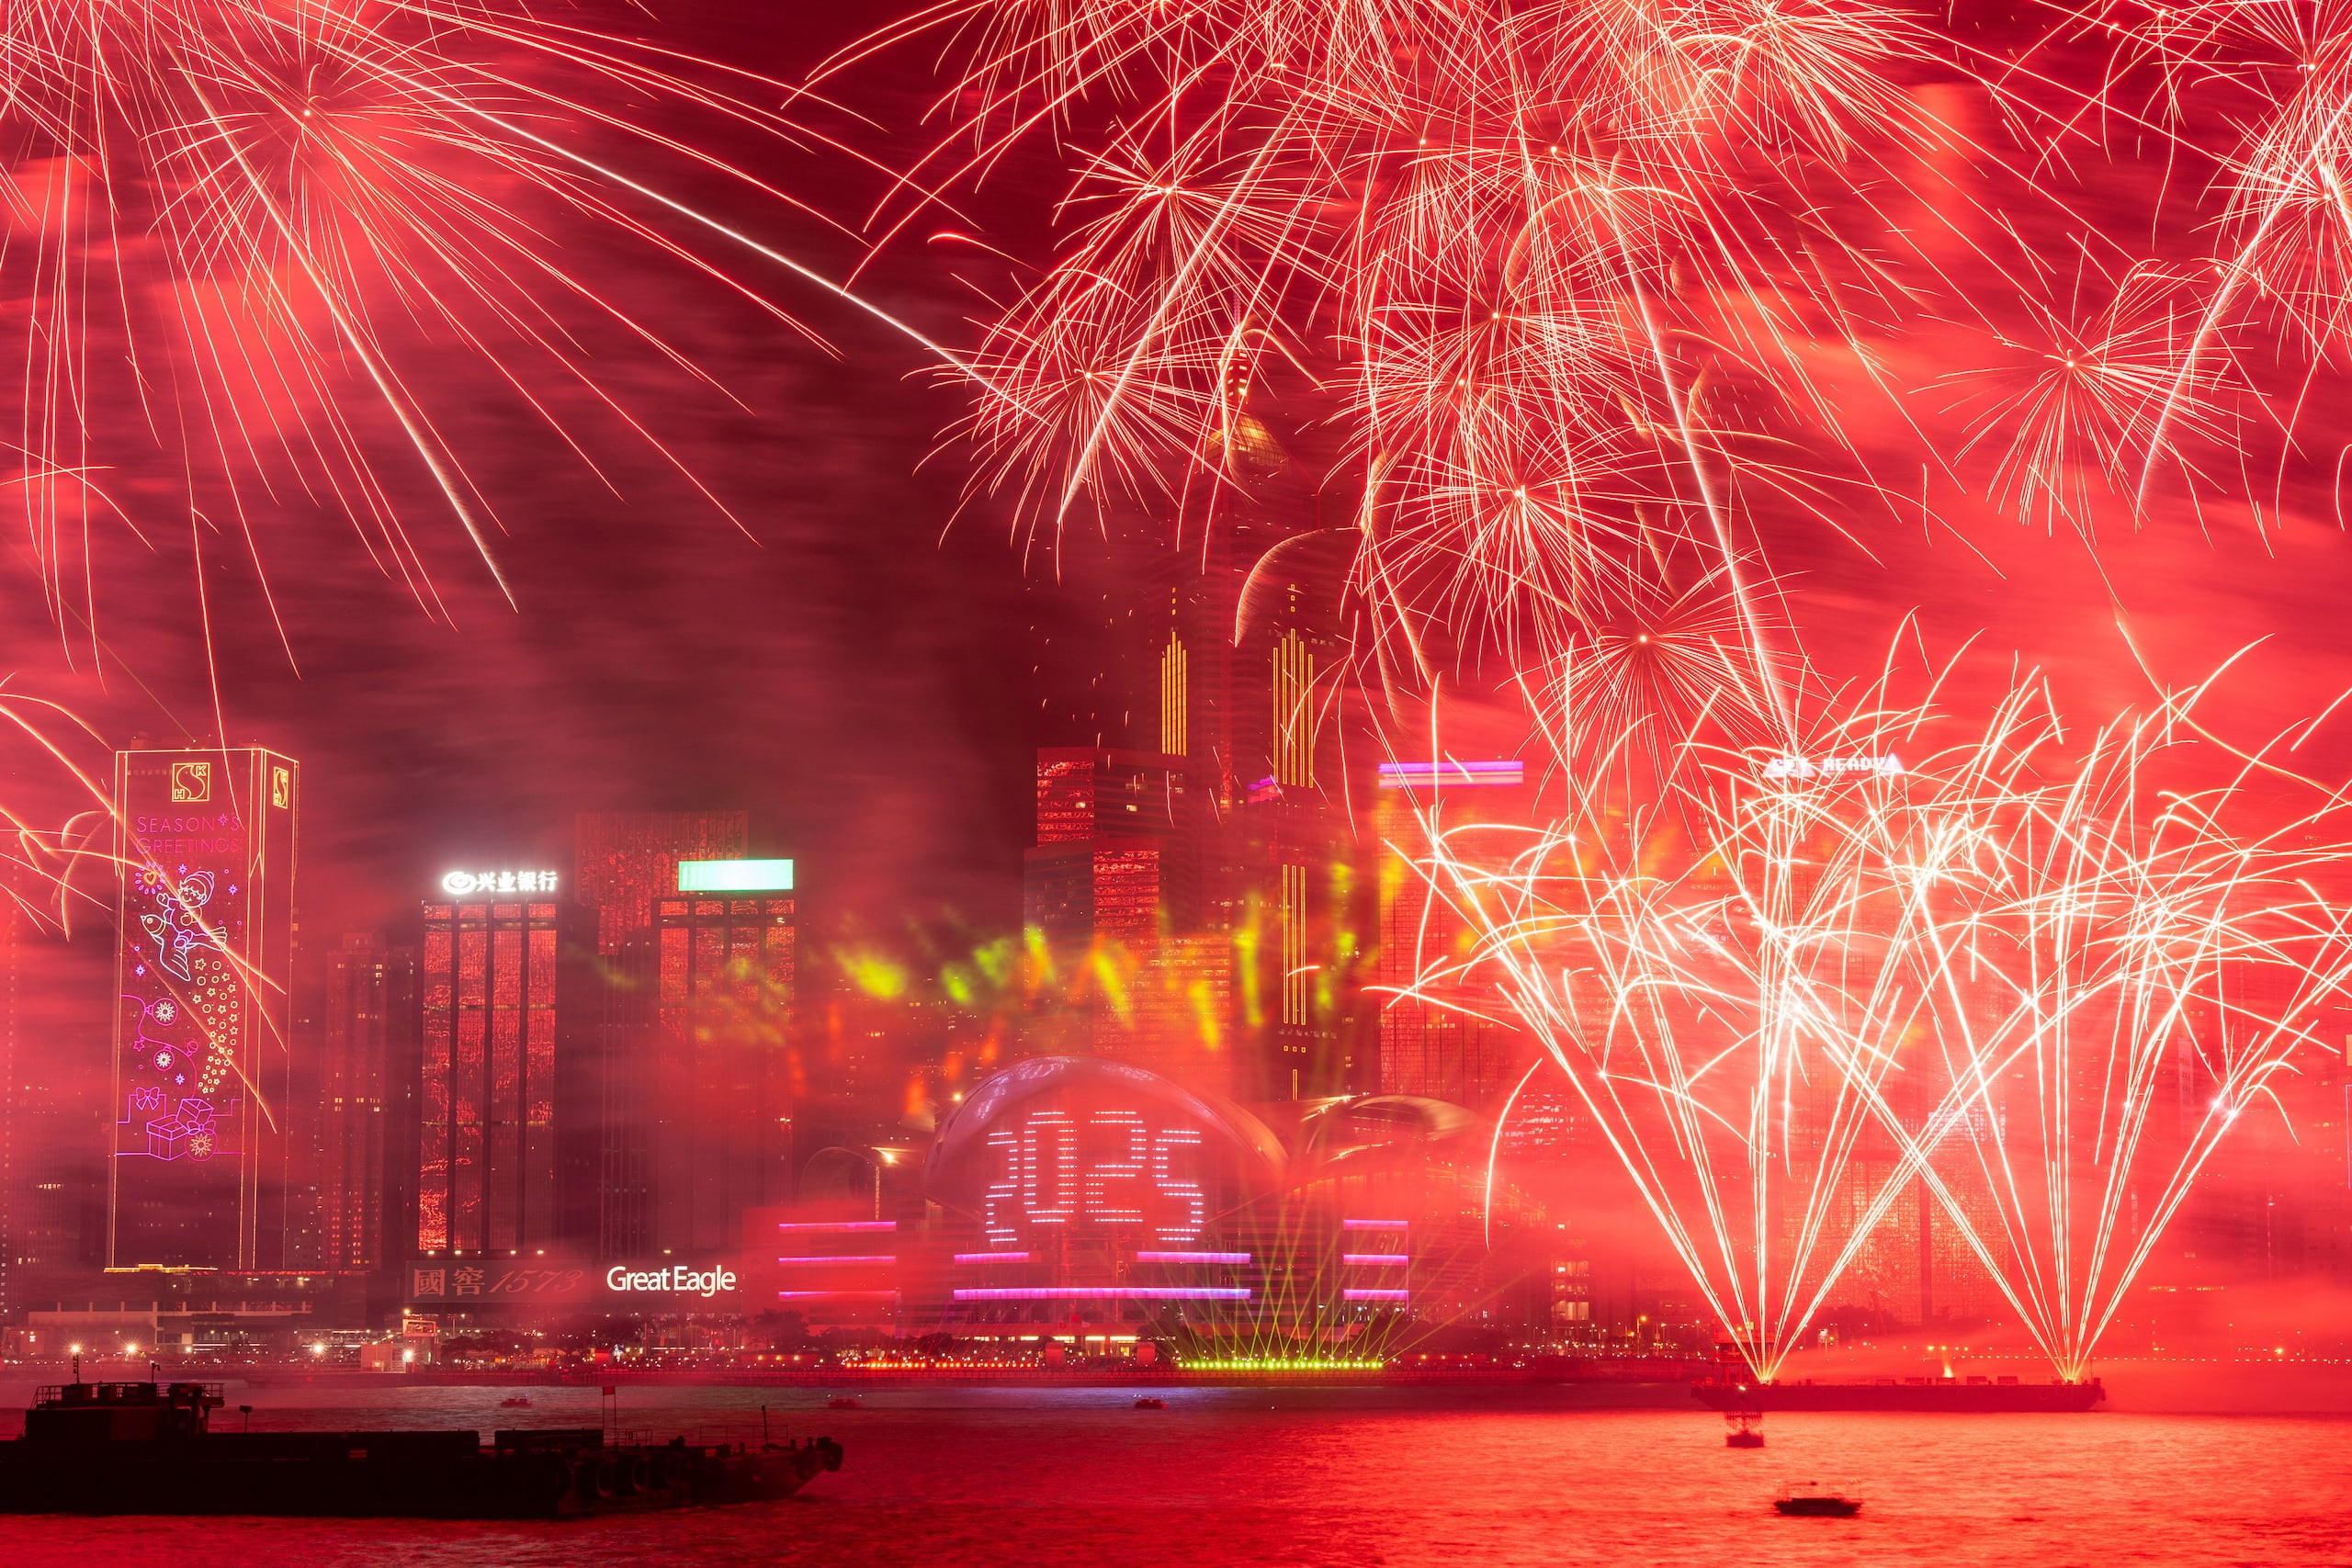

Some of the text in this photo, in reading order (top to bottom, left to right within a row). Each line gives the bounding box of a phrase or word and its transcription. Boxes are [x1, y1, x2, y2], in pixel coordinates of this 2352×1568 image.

[136, 837, 239, 854] GREETINGS
[476, 870, 558, 892] 兴业银行
[985, 1111, 1204, 1242] 2025
[413, 1266, 585, 1299] 國窖 1573
[606, 1265, 737, 1298] Great Eagle
